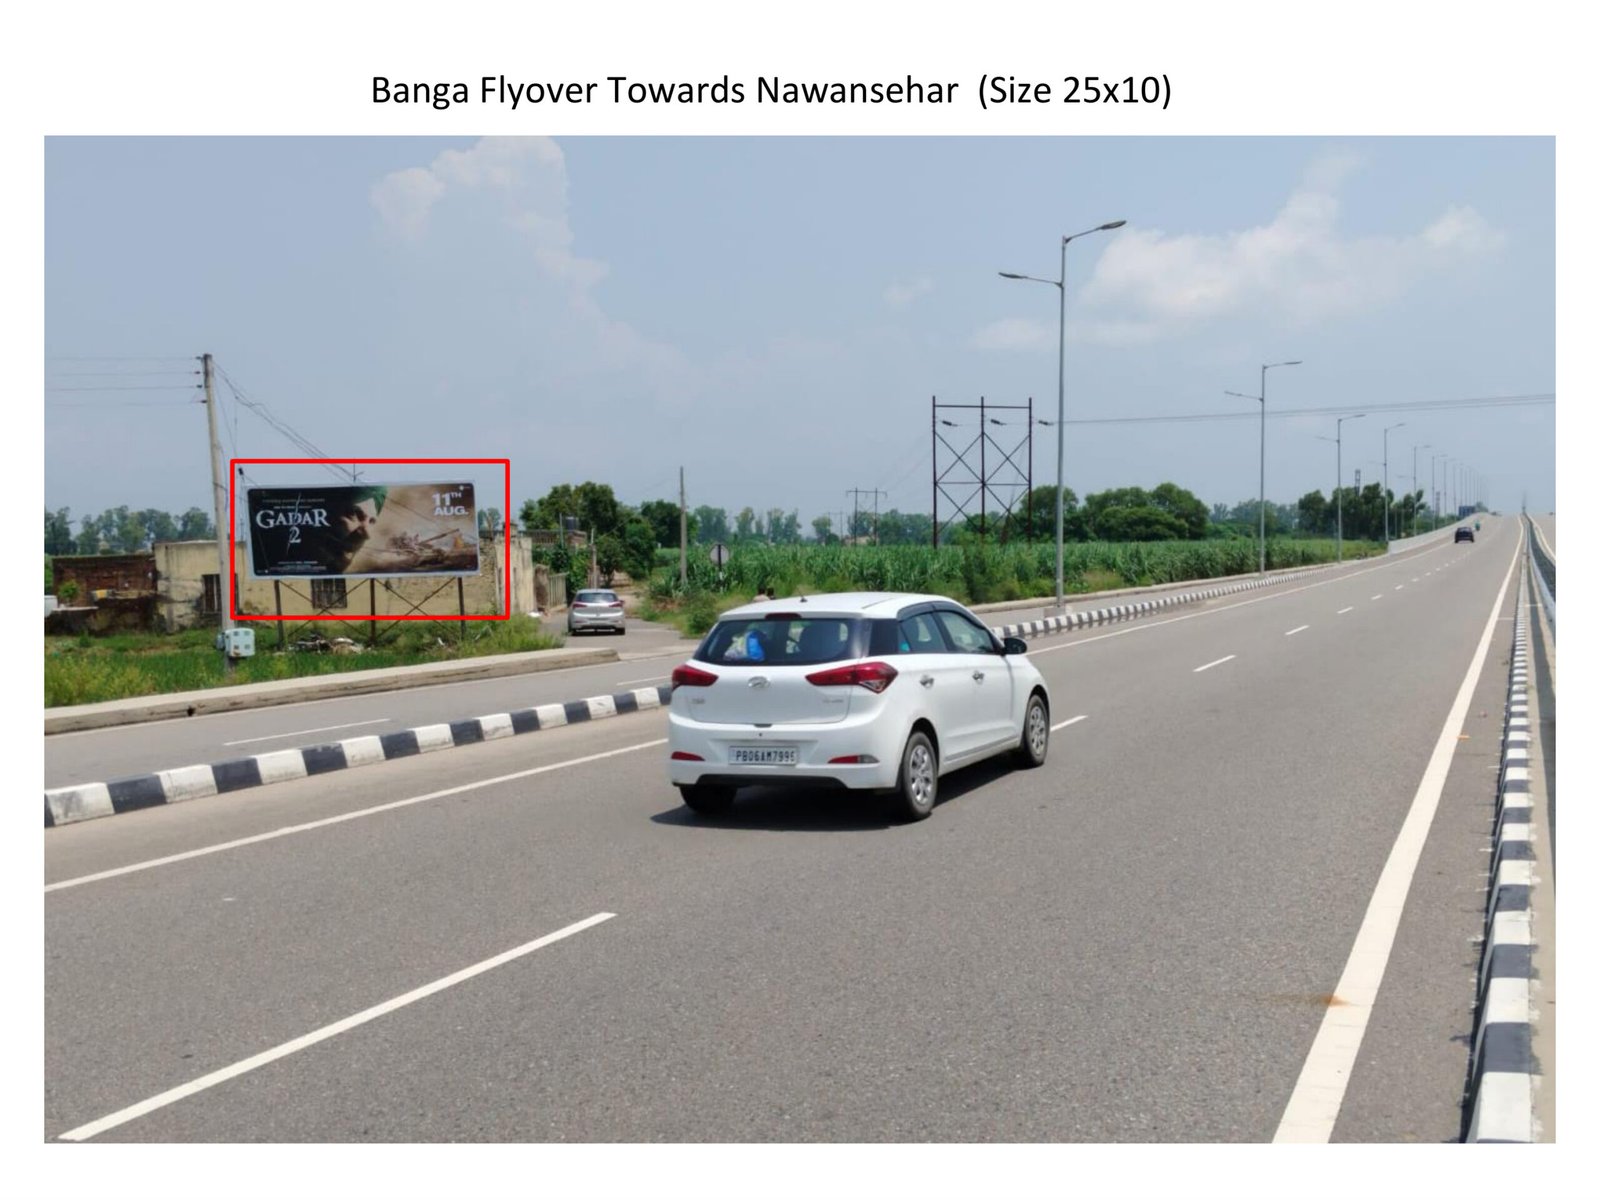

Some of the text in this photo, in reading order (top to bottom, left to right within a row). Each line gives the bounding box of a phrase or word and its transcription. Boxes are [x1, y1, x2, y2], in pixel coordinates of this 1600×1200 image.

[256, 508, 331, 529] GADAR
[433, 505, 469, 516] AUG.
[288, 526, 302, 544] 2
